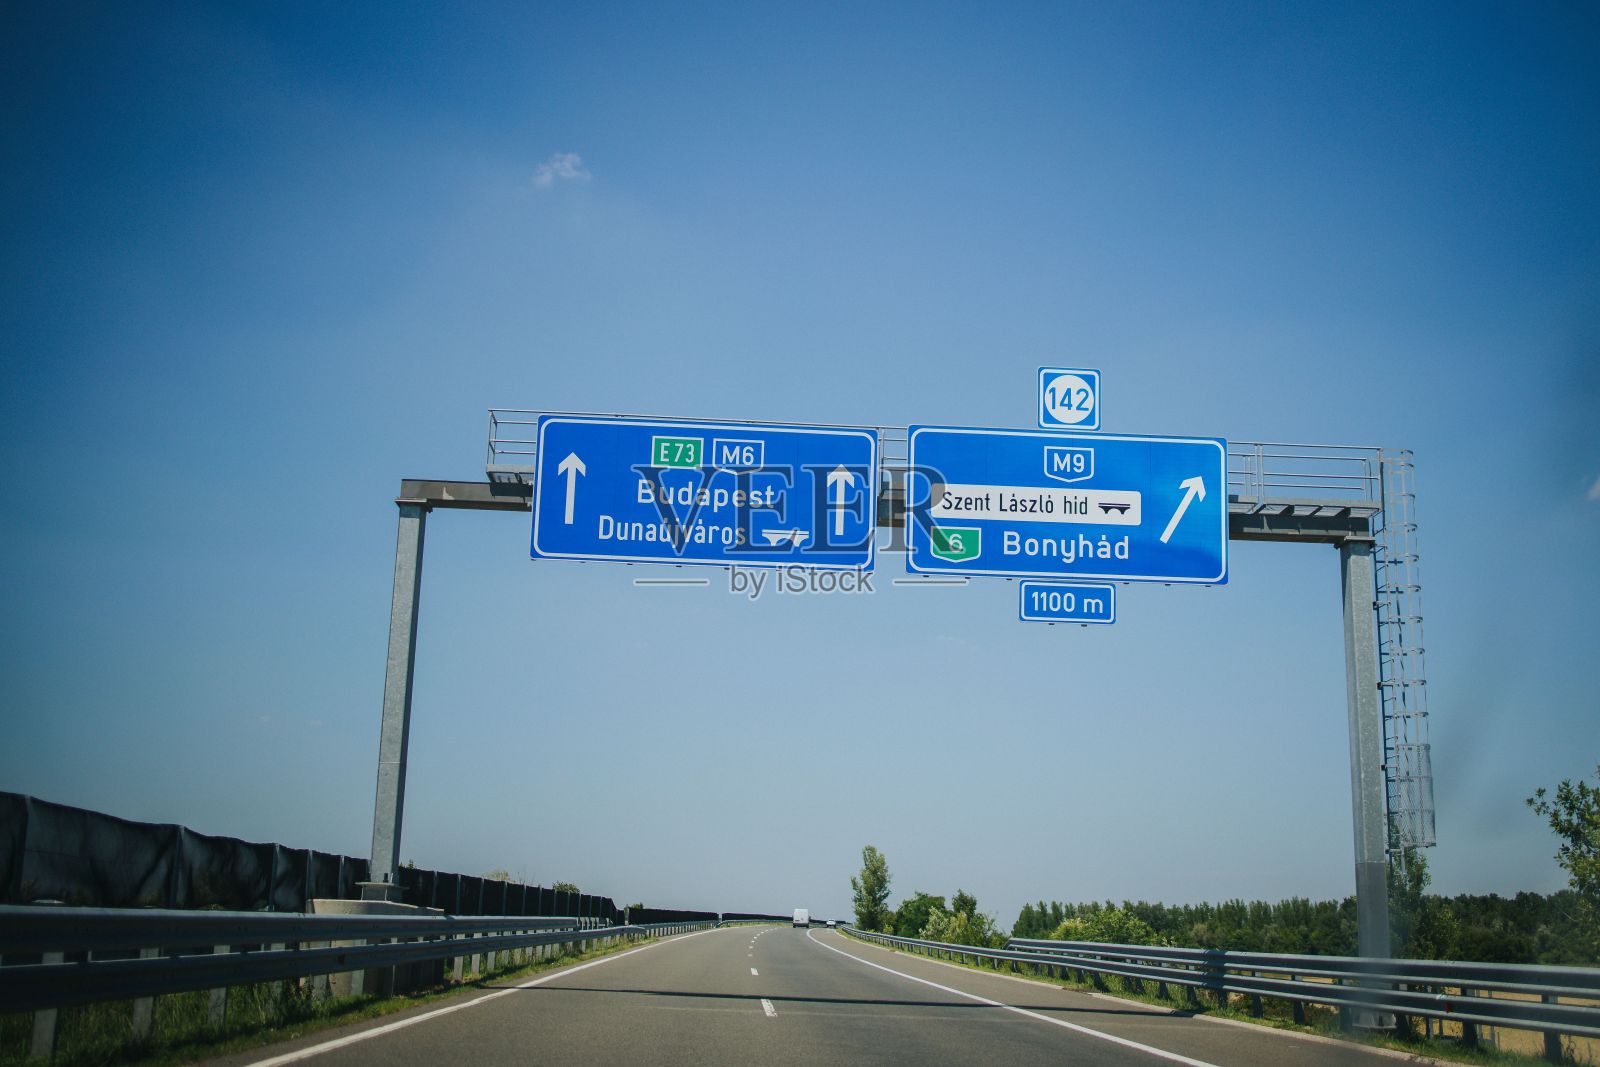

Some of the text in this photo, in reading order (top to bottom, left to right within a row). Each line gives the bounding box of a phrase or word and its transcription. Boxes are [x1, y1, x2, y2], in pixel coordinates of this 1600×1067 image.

[1048, 387, 1090, 412] 142
[659, 442, 695, 463] E73
[722, 445, 755, 467] M6
[1053, 453, 1086, 474] M9
[637, 479, 775, 513] Budapest
[942, 491, 991, 512] Szent
[999, 493, 1054, 514] László
[598, 515, 746, 547] Dunaújváros
[949, 533, 964, 553] 6
[1003, 531, 1129, 564] Bonyhád
[1031, 591, 1104, 614] 1100 m
